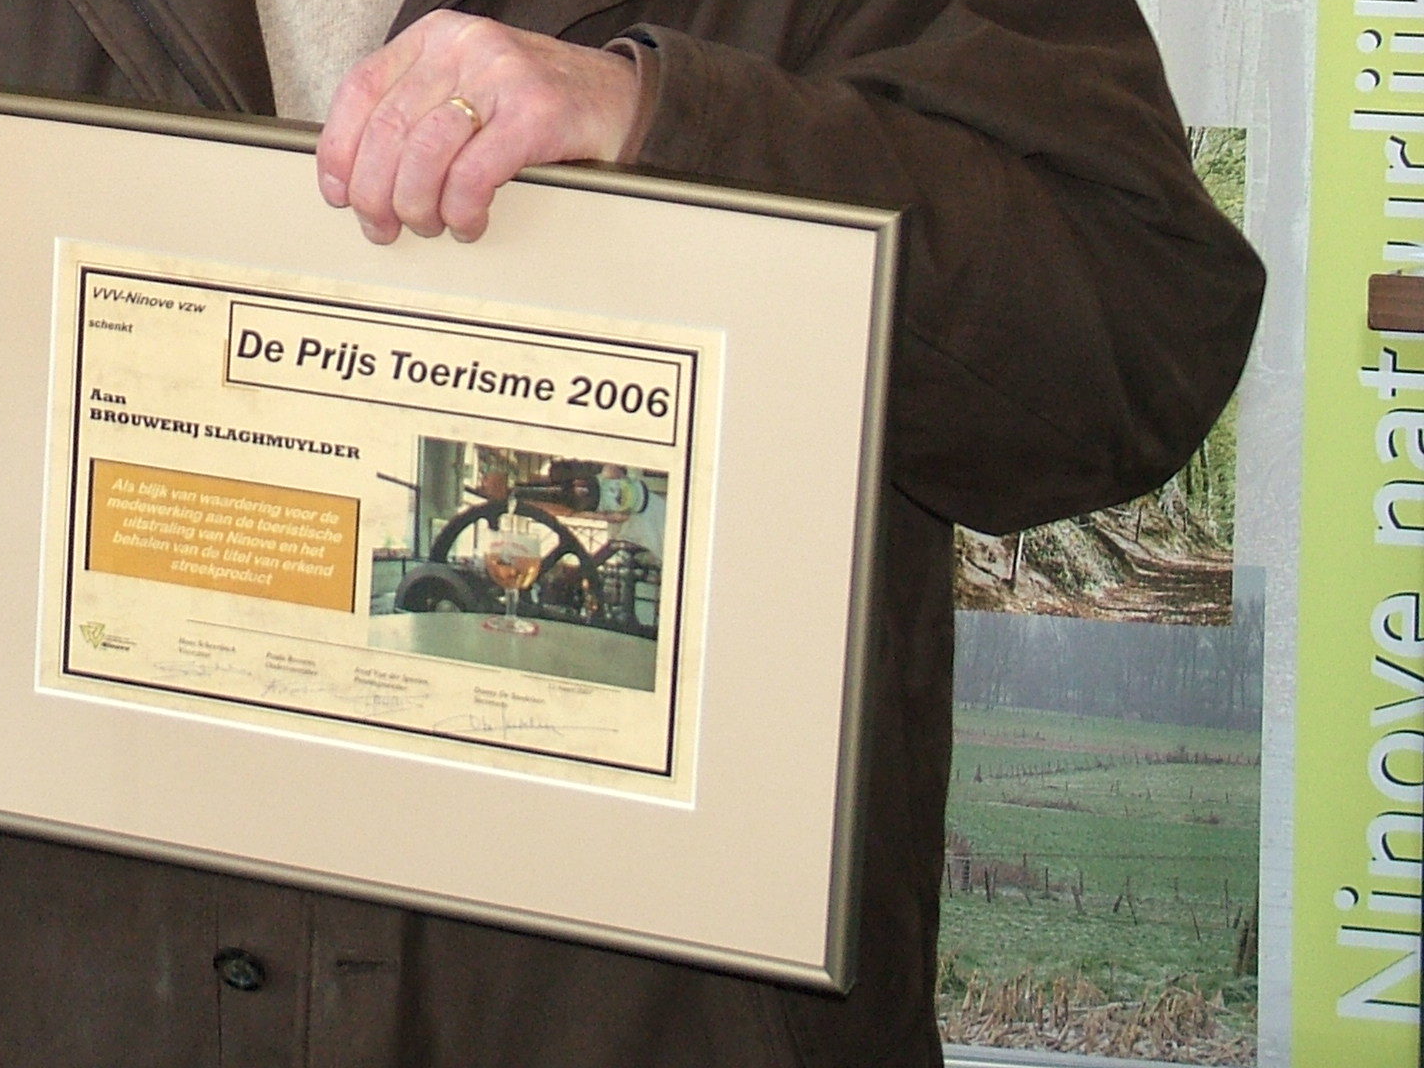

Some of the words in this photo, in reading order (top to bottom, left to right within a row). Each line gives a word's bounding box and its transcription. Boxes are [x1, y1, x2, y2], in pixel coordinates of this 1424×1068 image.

[93, 287, 174, 309] VVV-Ninove
[178, 301, 206, 313] vzw
[88, 318, 133, 333] schenkt
[236, 328, 284, 362] De
[296, 337, 376, 380] Prijs
[389, 350, 556, 401] Toerisme
[566, 375, 671, 418] 2006
[90, 388, 127, 405] Aan
[90, 408, 200, 438] BROUWERIJ
[204, 425, 361, 459] SLAGHMUYLDER
[107, 497, 203, 523] medewerking
[205, 512, 232, 525] aan
[235, 516, 254, 529] de
[257, 518, 343, 543] toeristische
[111, 478, 135, 492] Als
[138, 482, 168, 499] blijk
[172, 489, 196, 501] van
[200, 493, 282, 518] waardering
[284, 506, 318, 520] voor
[319, 511, 340, 524] de
[113, 530, 170, 550] behalen
[173, 542, 199, 555] van
[201, 546, 220, 558] de
[223, 548, 252, 563] titel
[254, 555, 279, 568] van
[282, 560, 335, 577] erkend
[123, 516, 196, 539] uitstraling
[198, 529, 223, 541] van
[226, 531, 277, 549] Ninove
[279, 542, 298, 552] en
[300, 542, 326, 558] het
[171, 559, 273, 585] streekproduct
[1337, 592, 1424, 1022] Ninove
